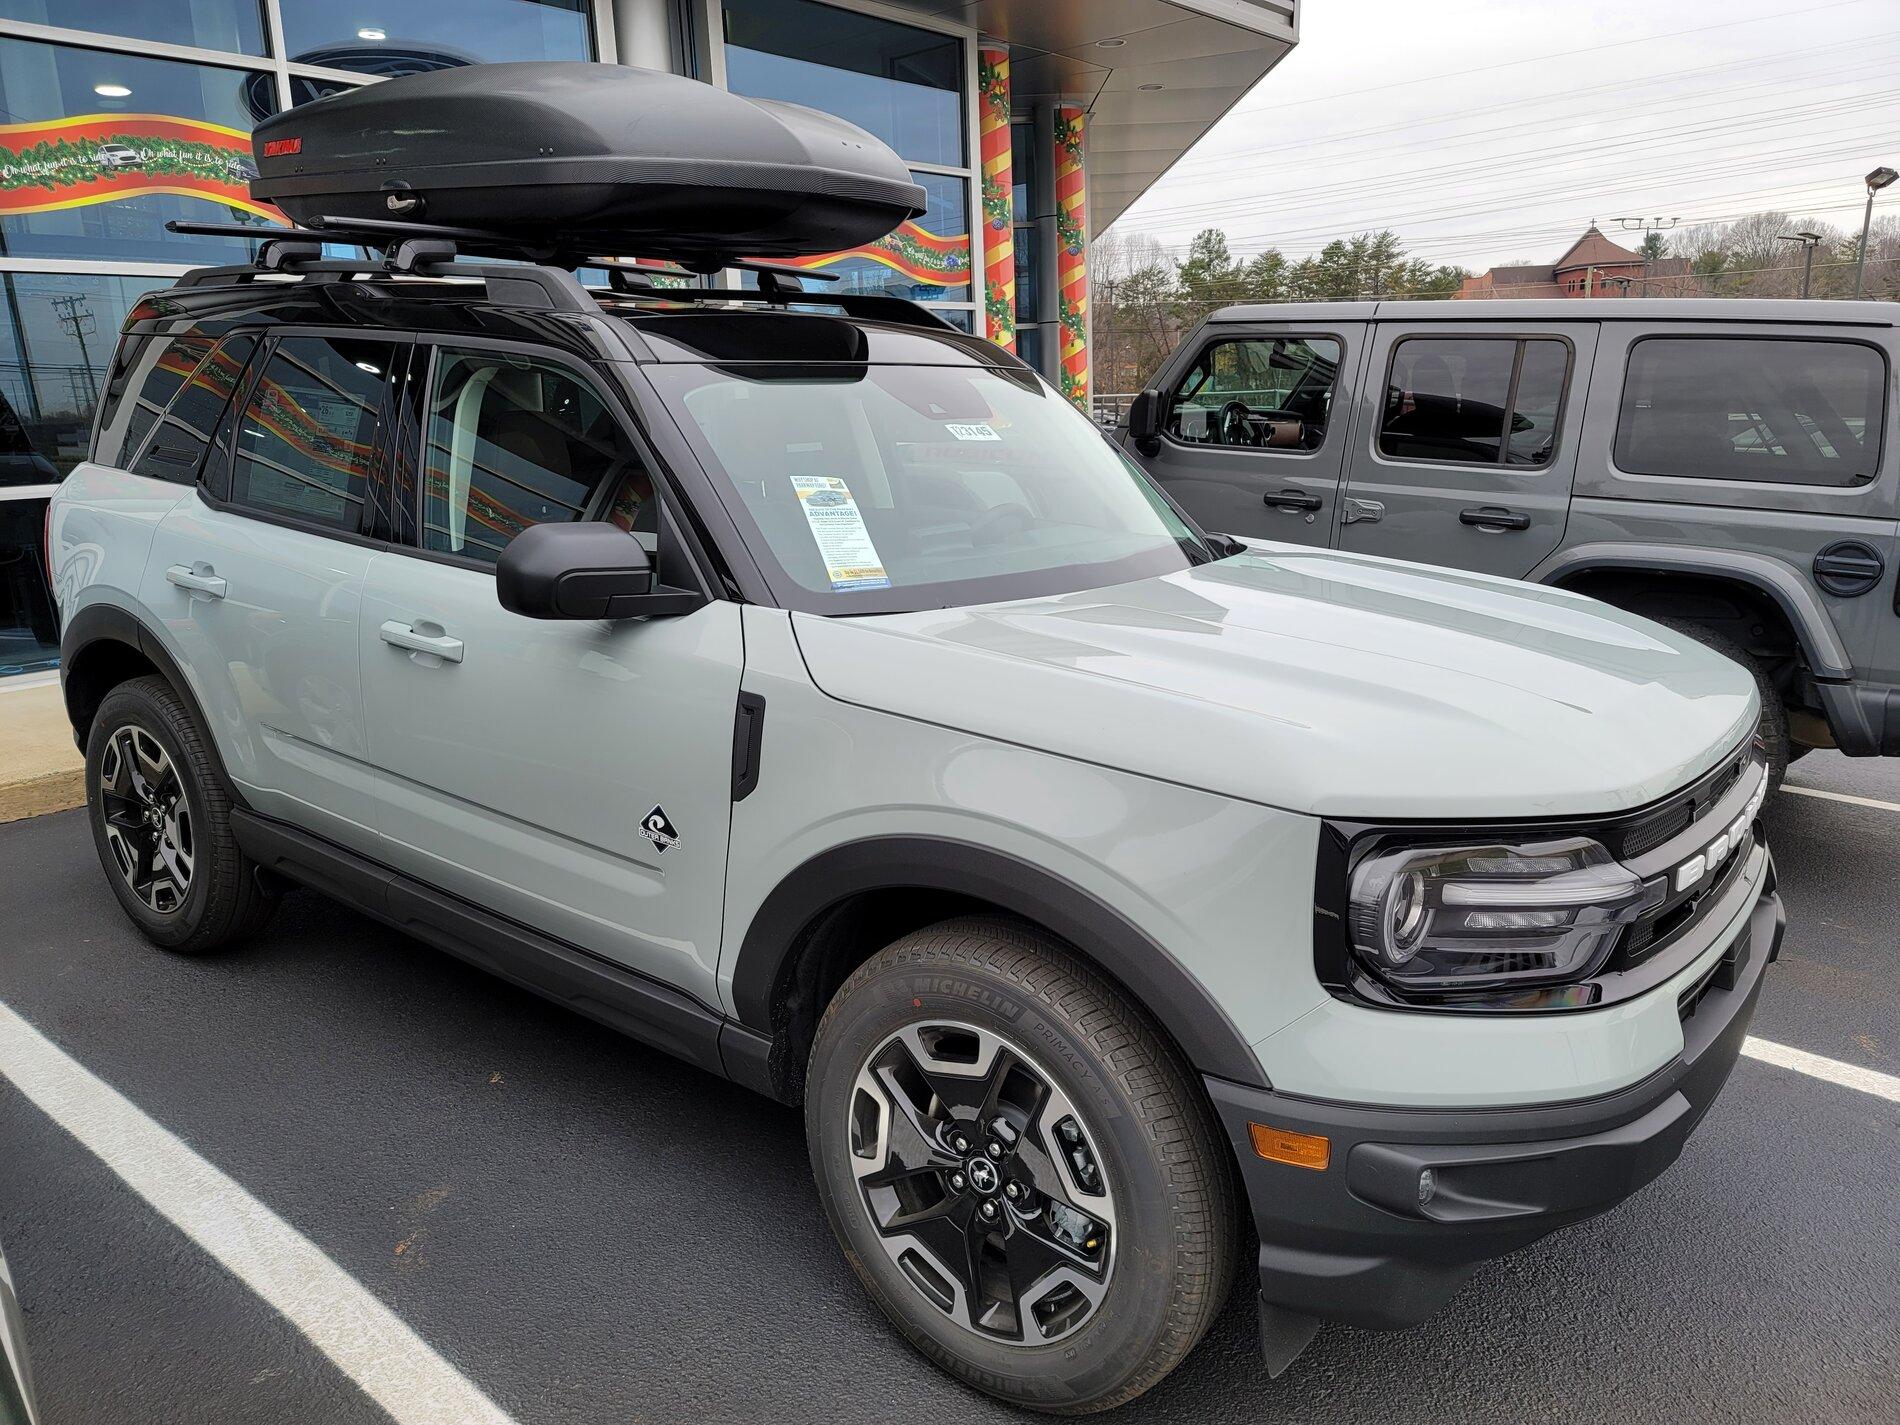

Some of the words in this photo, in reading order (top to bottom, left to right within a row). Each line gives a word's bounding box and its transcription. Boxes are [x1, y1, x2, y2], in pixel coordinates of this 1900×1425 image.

[2, 164, 18, 179] Oh
[20, 161, 42, 174] what
[41, 160, 59, 176] fun
[78, 154, 88, 164] to
[140, 147, 154, 161] Oh
[157, 148, 177, 159] what
[179, 149, 193, 164] fun
[195, 149, 203, 161] it
[204, 152, 213, 162] is
[215, 154, 224, 165] to
[226, 157, 241, 171] ride
[914, 977, 1020, 1018] MICHELIN
[1034, 1022, 1093, 1080] PRIMACY
